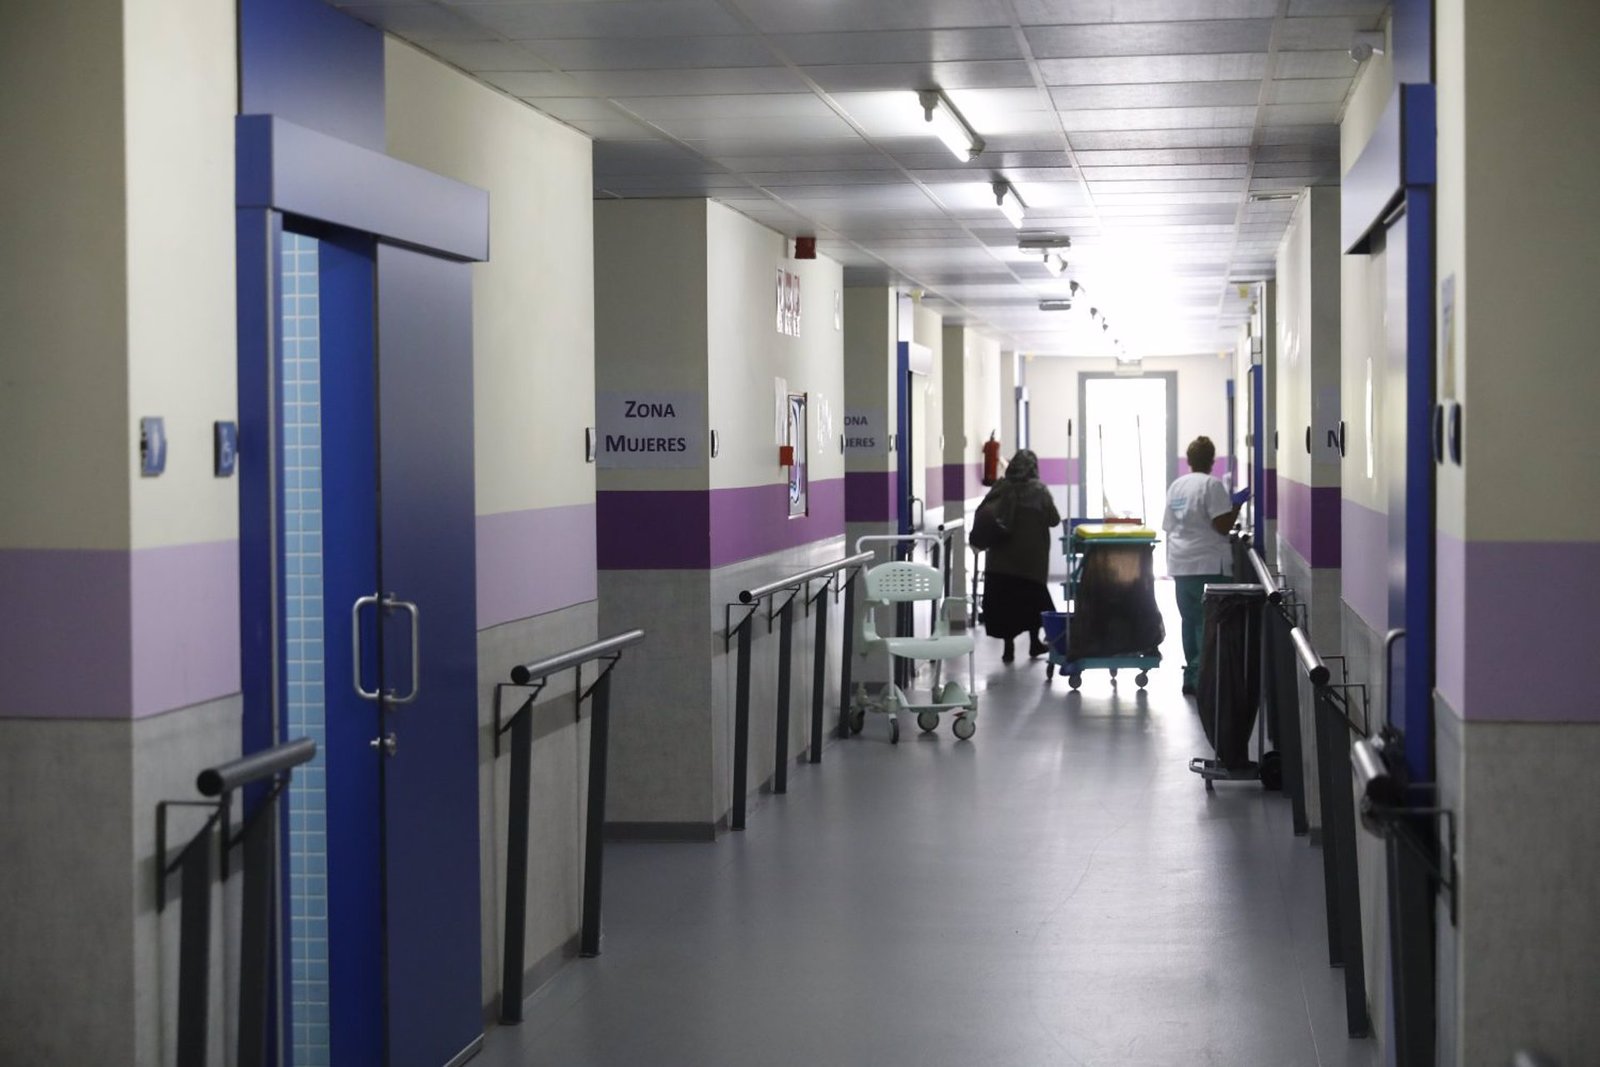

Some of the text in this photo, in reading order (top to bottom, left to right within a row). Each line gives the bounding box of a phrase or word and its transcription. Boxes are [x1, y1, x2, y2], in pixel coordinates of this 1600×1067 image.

[625, 400, 676, 418] ZONA
[844, 415, 868, 426] ONA
[605, 434, 686, 452] MUJERES
